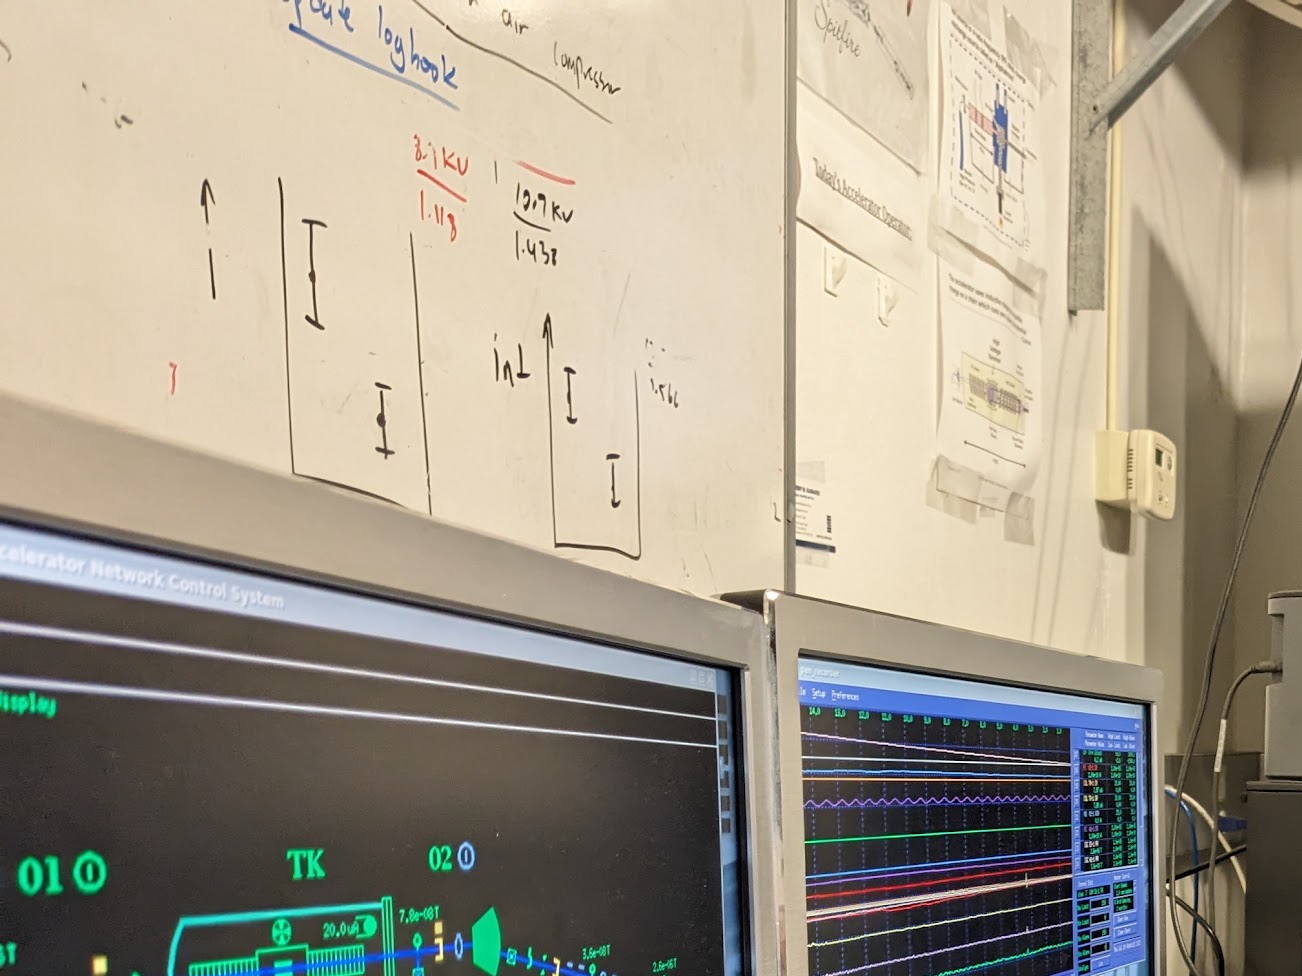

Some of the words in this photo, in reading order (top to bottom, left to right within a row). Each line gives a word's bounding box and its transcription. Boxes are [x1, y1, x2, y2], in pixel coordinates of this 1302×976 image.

[814, 0, 861, 58] Spitfire
[842, 178, 881, 222] Accelerator
[90, 559, 164, 589] Network
[168, 575, 226, 599] Control
[230, 585, 285, 609] System
[18, 857, 62, 895] 01
[287, 849, 325, 880] TK
[428, 845, 452, 870] 02
